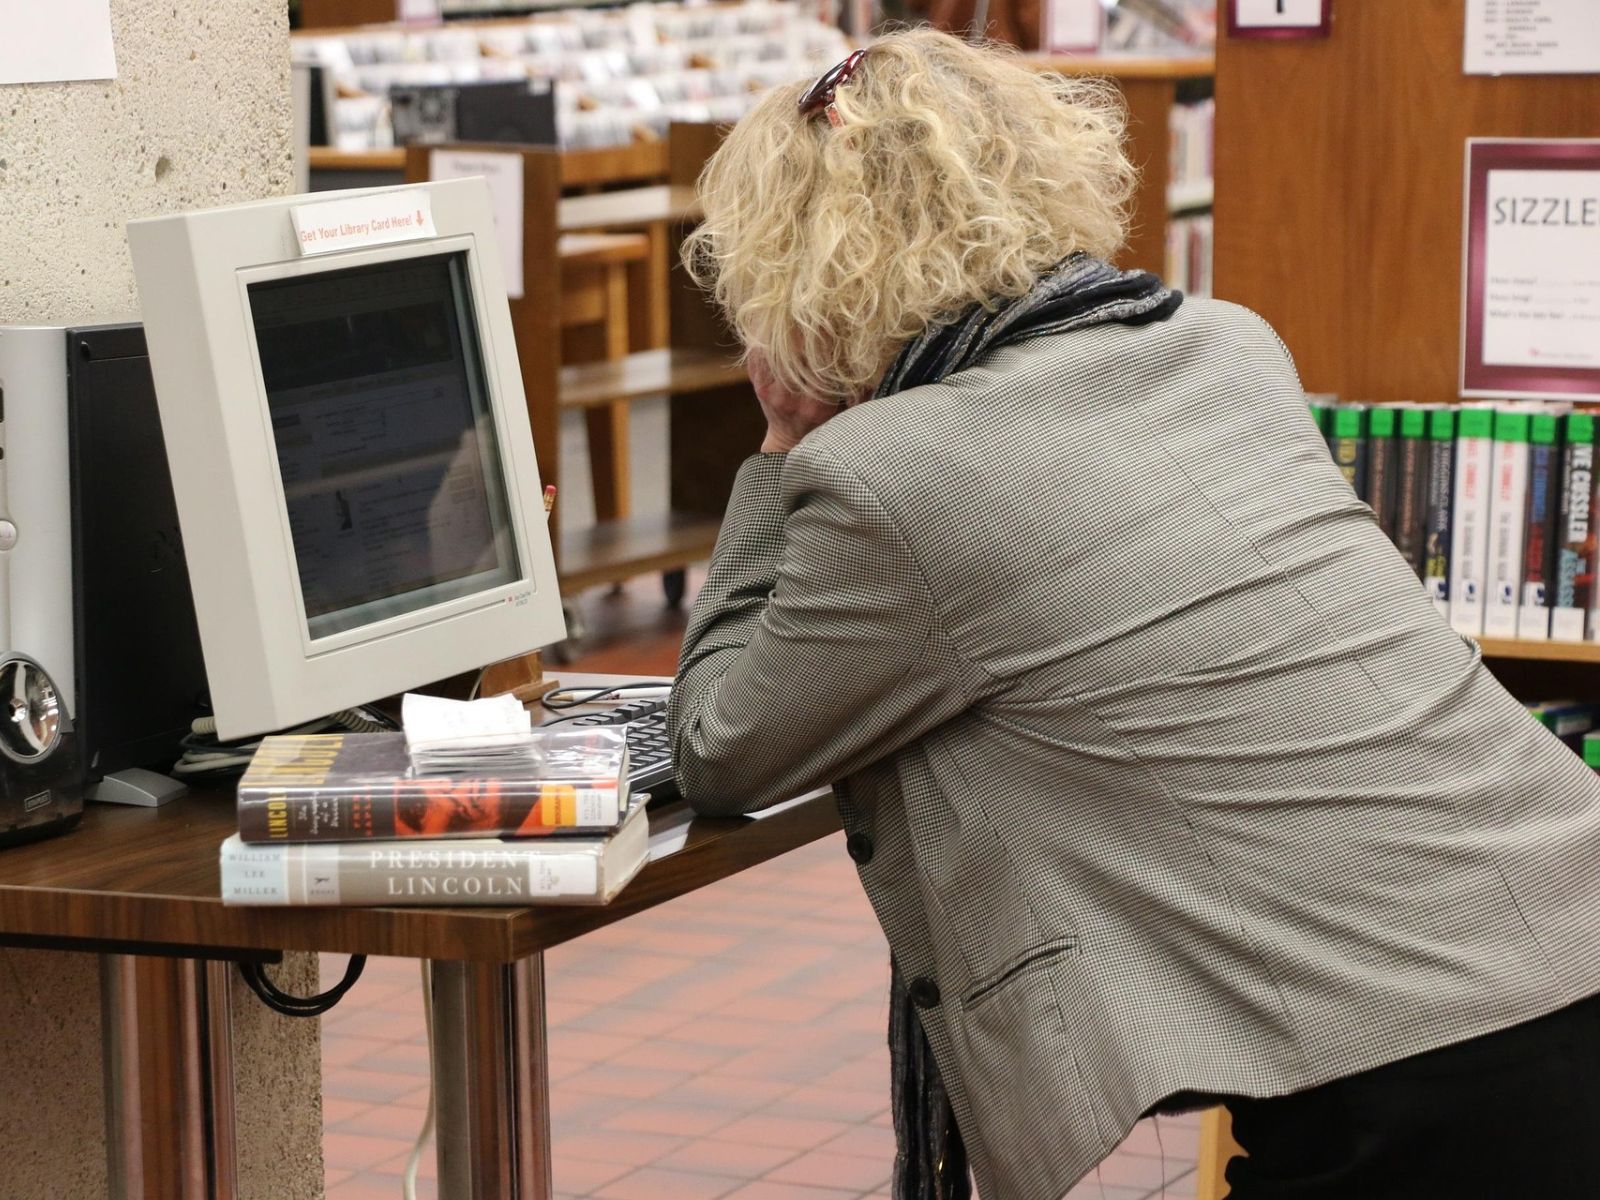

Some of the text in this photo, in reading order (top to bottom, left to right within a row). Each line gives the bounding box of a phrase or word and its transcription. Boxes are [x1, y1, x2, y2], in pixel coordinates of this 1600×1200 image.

[1494, 198, 1600, 225] SIZZLE
[301, 215, 412, 242] Get Your Library Card Here!
[1568, 470, 1591, 542] CUSSLER
[229, 853, 281, 862] WILLIAM
[244, 870, 265, 878] LEE
[234, 886, 278, 895] MILLER
[388, 877, 523, 895] LINCOLN
